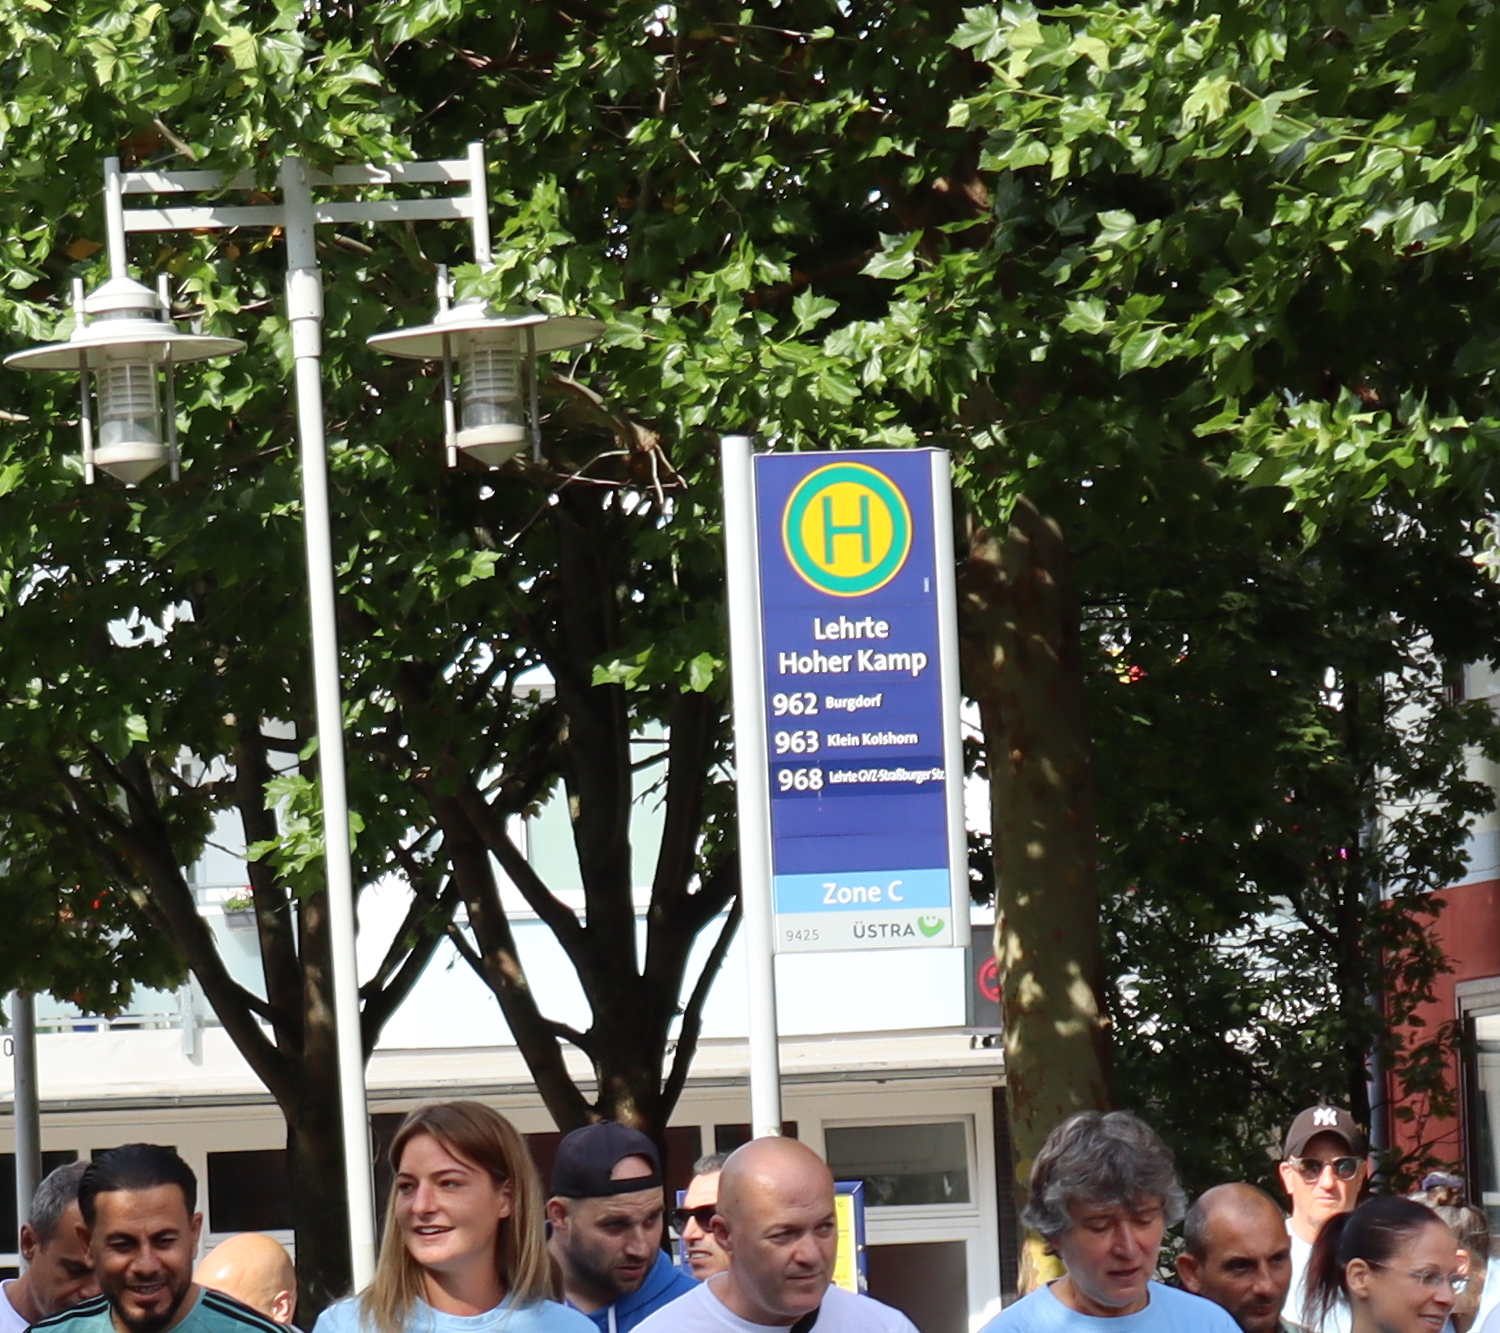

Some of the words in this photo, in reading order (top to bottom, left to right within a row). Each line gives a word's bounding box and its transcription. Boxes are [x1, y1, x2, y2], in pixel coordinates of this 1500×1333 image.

[823, 494, 871, 565] H
[814, 616, 889, 640] Lehrte
[779, 650, 853, 674] Hoher
[858, 649, 927, 677] Kamp
[772, 692, 818, 716] 962
[825, 693, 883, 712] Burgdorf
[775, 731, 819, 754] 963
[828, 734, 859, 747] Klein
[862, 732, 918, 746] Kolshorn
[779, 768, 824, 791] 968
[829, 771, 857, 783] Lehrte
[822, 883, 881, 904] Zone
[888, 880, 904, 901] C
[786, 929, 820, 942] 9425
[853, 921, 916, 939] ÜSTRA
